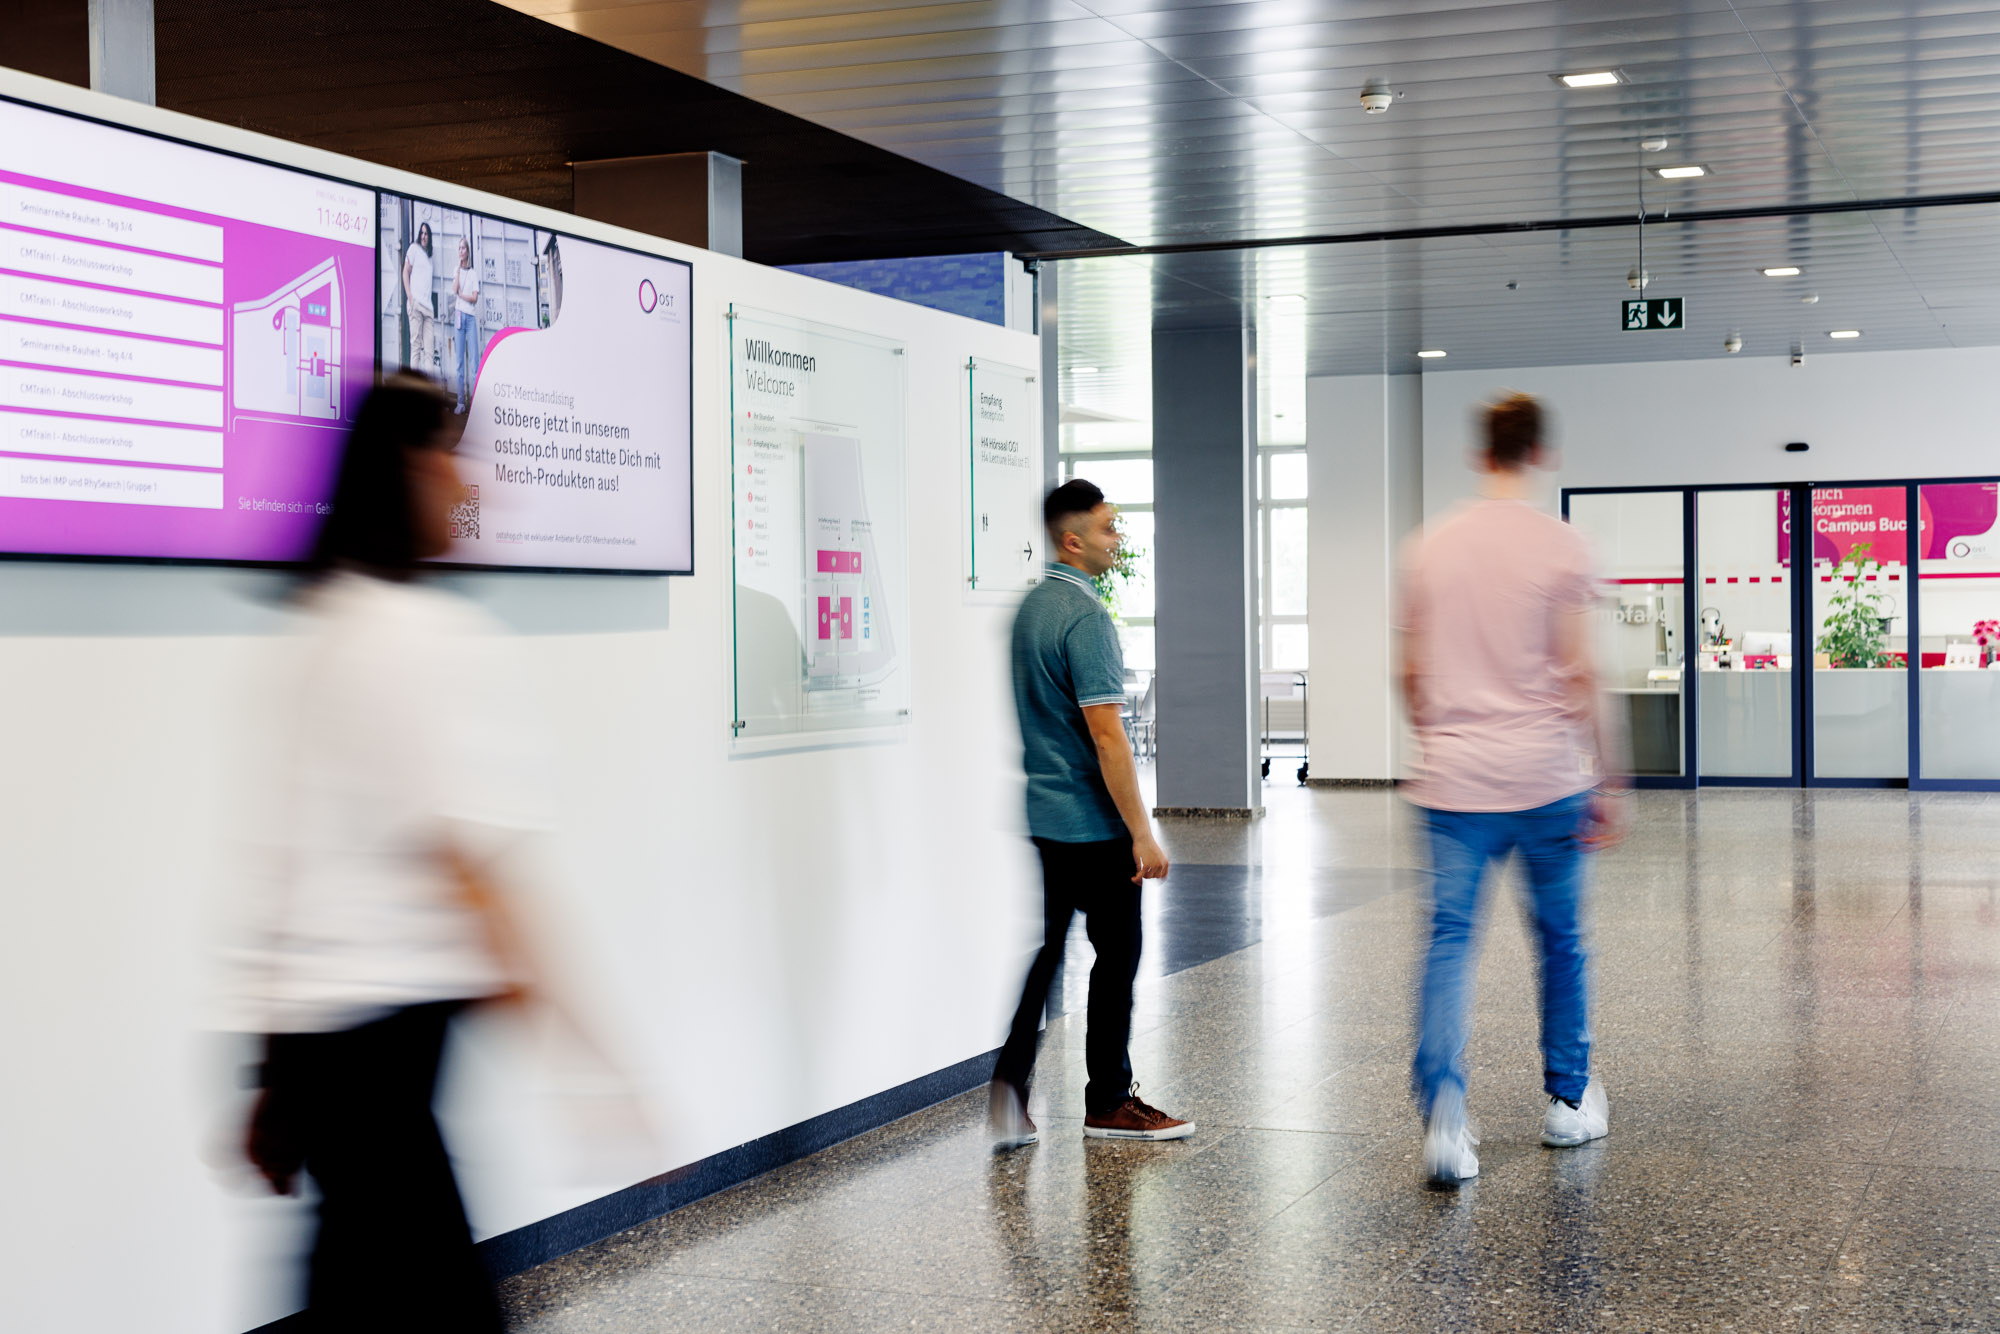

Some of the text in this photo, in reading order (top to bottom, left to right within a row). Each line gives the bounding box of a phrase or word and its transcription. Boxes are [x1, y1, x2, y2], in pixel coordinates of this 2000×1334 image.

[20, 201, 71, 219] Seminarreihe
[72, 211, 101, 226] Rauheit
[107, 217, 119, 232] Tag
[317, 207, 368, 235] 11:48:47
[20, 247, 51, 261] CMTrain
[62, 255, 133, 277] Abschlussworkshop
[20, 292, 51, 306] CMTrain
[62, 298, 133, 320] Abschlussworkshop
[659, 293, 674, 307] OST
[20, 338, 71, 354] Seminarreihe
[72, 344, 101, 358] Rauheit
[107, 349, 119, 363] Tag
[745, 338, 816, 373] Willkommen
[20, 383, 51, 396] CMTrain
[61, 388, 134, 406] Abschlussworkshop
[493, 382, 575, 410] OST-Merchandising
[746, 369, 795, 398] Welcome
[981, 392, 1002, 411] Empfang
[494, 406, 630, 440] Stöbere jetzt in unserem
[981, 407, 1004, 424] Reception
[20, 428, 51, 441] CMTrain
[61, 432, 134, 449] Abschlussworkshop
[989, 438, 1007, 452] Hörsaal
[1008, 440, 1018, 453] OG1
[494, 437, 661, 470] ostshop.ch und statte Dich mit
[40, 475, 51, 485] bei
[53, 476, 67, 486] IMP
[69, 478, 82, 488] und
[84, 478, 121, 490] RhySearch
[126, 480, 152, 493] Gruppe
[495, 462, 620, 493] Merch-Produkten aus!
[238, 497, 251, 510] Sie
[252, 498, 286, 513] befinden
[287, 501, 303, 513] sich
[304, 503, 314, 514] im
[1816, 517, 1925, 535] Campus Bucs
